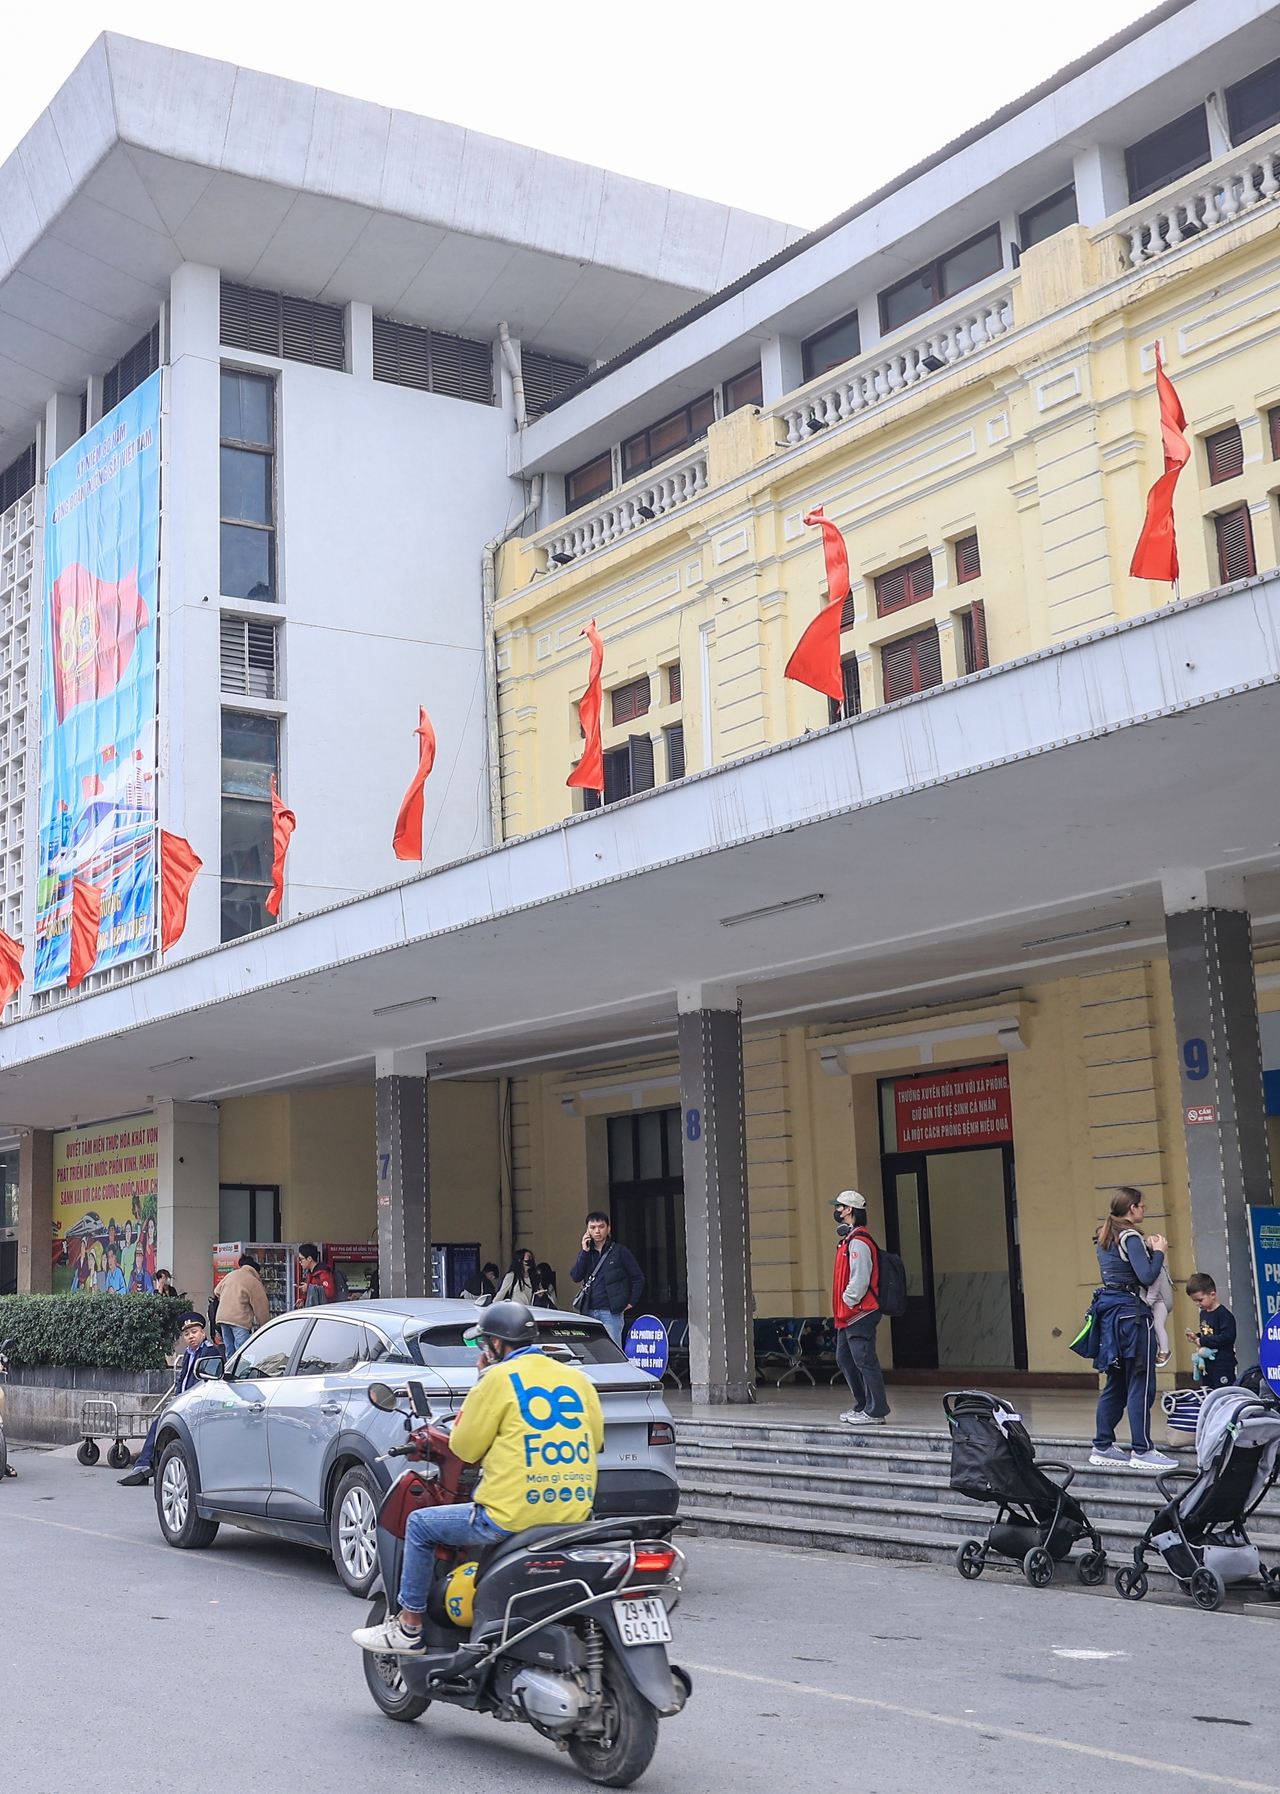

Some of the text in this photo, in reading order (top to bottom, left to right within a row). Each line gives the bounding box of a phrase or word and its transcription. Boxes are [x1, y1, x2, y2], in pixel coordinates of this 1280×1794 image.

[122, 441, 135, 467] VIỆT
[1183, 1037, 1210, 1081] 9
[898, 1075, 1010, 1103] THƯỜNG XUYÊN RỬA TAY VỚI XÀ PHÒNG,
[912, 1096, 997, 1121] GIỮ GÌN TỐT VỆ SINH CÁ NHÂN
[686, 1108, 701, 1141] 8
[903, 1114, 1009, 1143] LÀ MỘT CÁCH PHÒNG BỆNH HIỆU QUẢ
[66, 1127, 158, 1159] QUYẾT TÂM HIỆN THỰC HÓA KHÁT VỌN
[57, 1153, 155, 1182] PHÁT TRIỂN ĐẤT NƯỚC PHỒN VINH, HẠNH
[380, 1153, 390, 1180] 7
[60, 1188, 73, 1205] SÁNH
[91, 1184, 101, 1201] CÁC
[102, 1181, 119, 1200] CƯỜNG
[120, 1176, 134, 1199] QUỐC
[136, 1177, 148, 1195] NĂM
[150, 1178, 158, 1194] CH
[1264, 1263, 1280, 1284] PH
[630, 1329, 663, 1342] CÁC PHƯƠNG TIỆN
[649, 1341, 656, 1354] ĐỖ
[641, 1357, 649, 1368] QUÁ
[649, 1358, 653, 1368] 5
[653, 1356, 663, 1368] PHÚT
[509, 1372, 584, 1431] be
[524, 1433, 590, 1467] Food
[526, 1471, 584, 1483] Món gì cũng
[448, 1597, 464, 1617] be
[623, 1621, 669, 1642] 649.74
